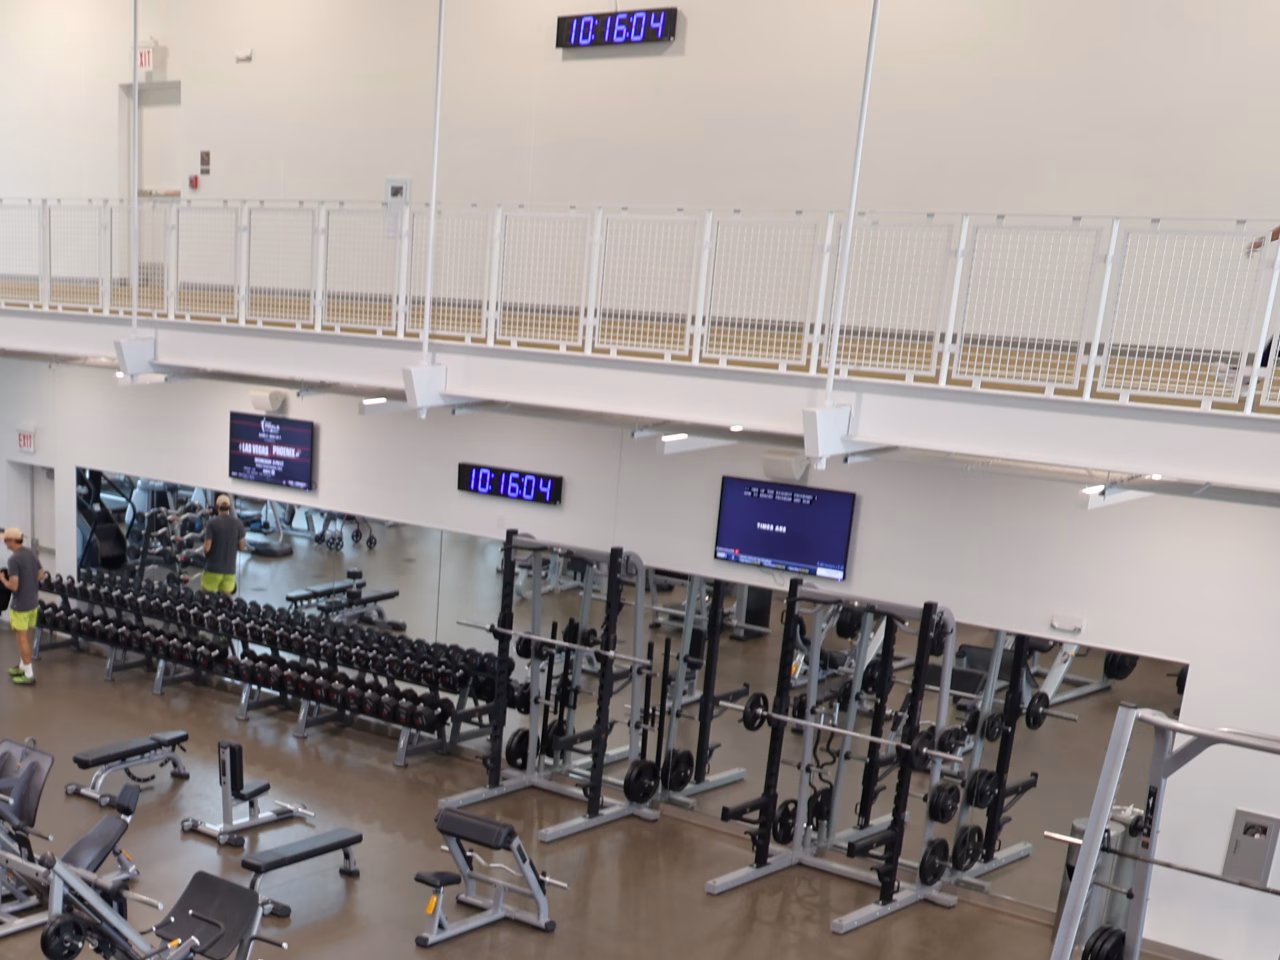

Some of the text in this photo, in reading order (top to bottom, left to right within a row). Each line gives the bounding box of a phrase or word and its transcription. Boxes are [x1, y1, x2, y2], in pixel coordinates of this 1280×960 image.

[570, 11, 666, 46] 10:16:04
[138, 49, 151, 68] XIT
[18, 432, 32, 449] EXIT
[242, 442, 296, 458] LAS VEGAS PHOENIX
[469, 467, 552, 502] 10:16:04
